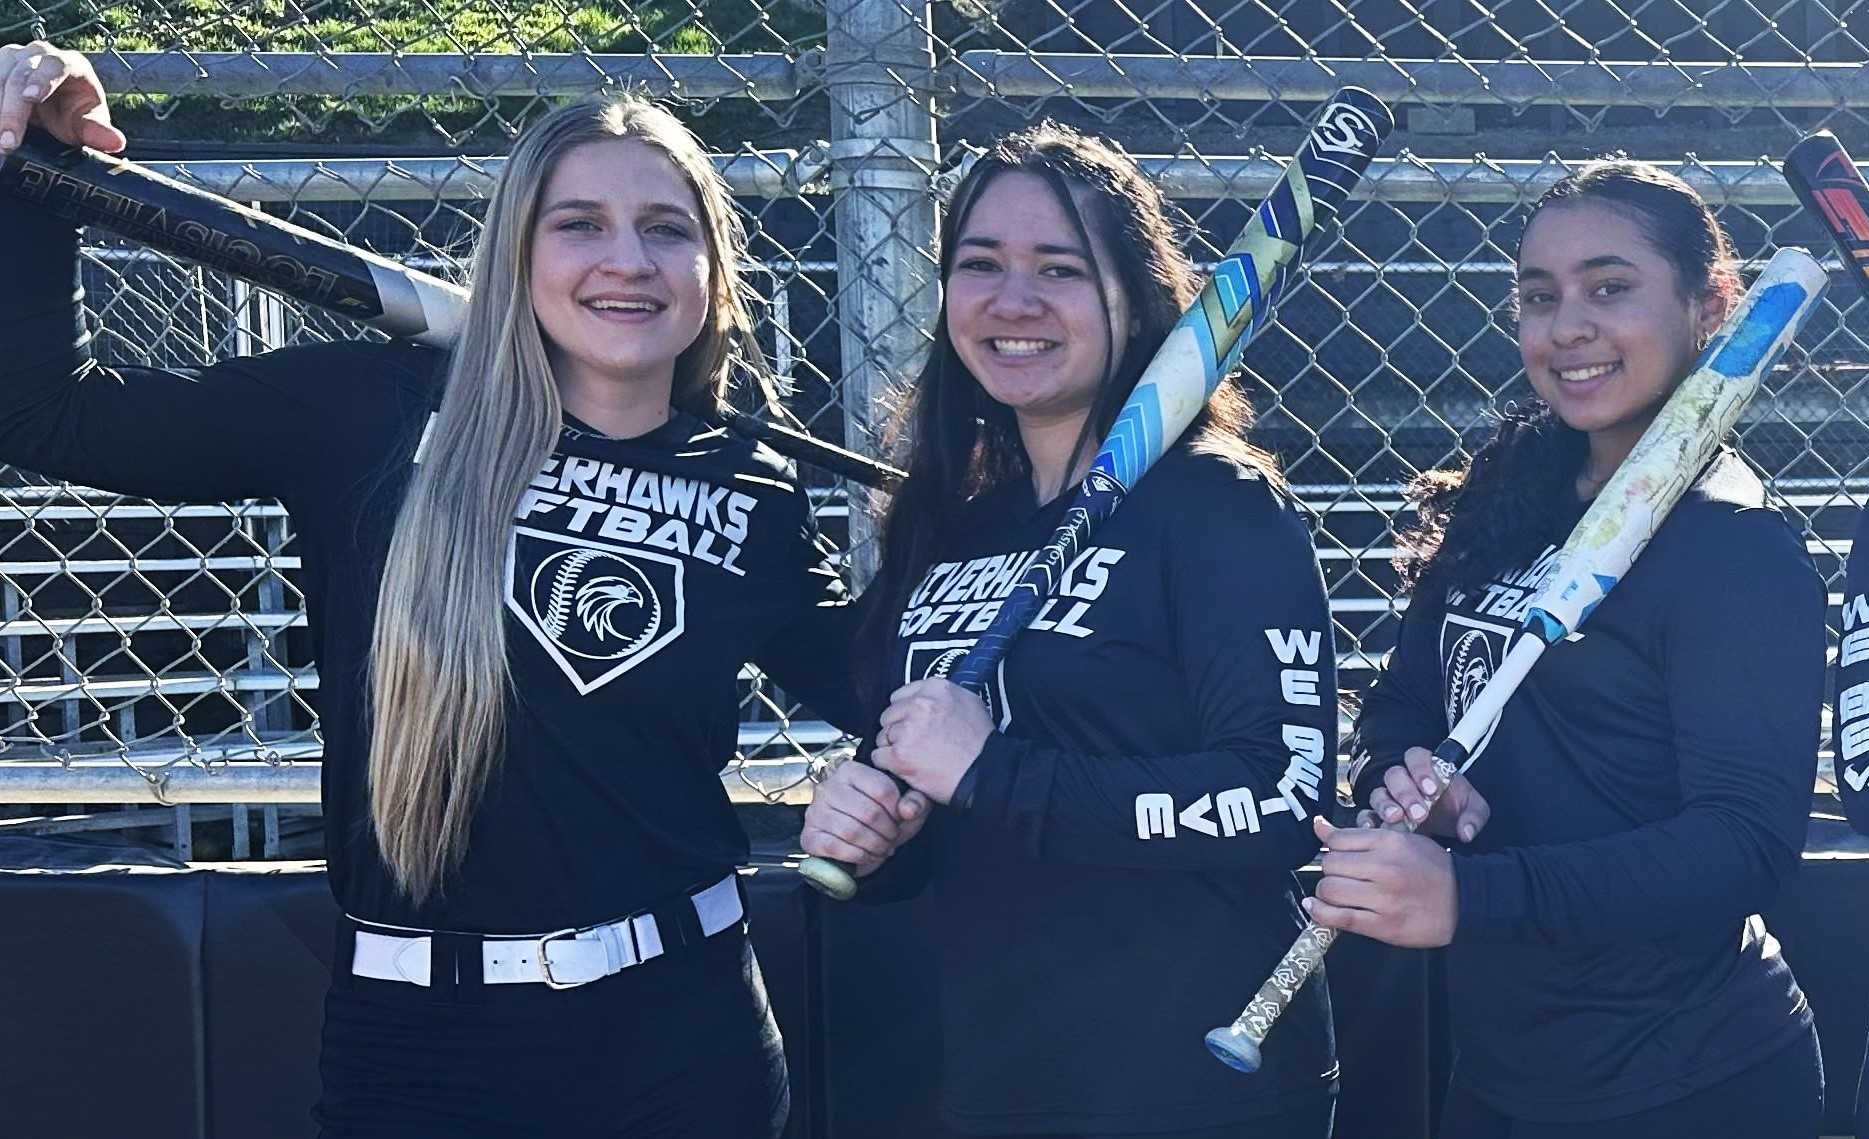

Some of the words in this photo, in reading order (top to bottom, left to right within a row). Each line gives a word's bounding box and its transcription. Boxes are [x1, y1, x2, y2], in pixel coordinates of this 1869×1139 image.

[511, 487, 747, 577] FTBALL
[526, 452, 758, 544] ERHAWKS
[1264, 628, 1322, 707] WE
